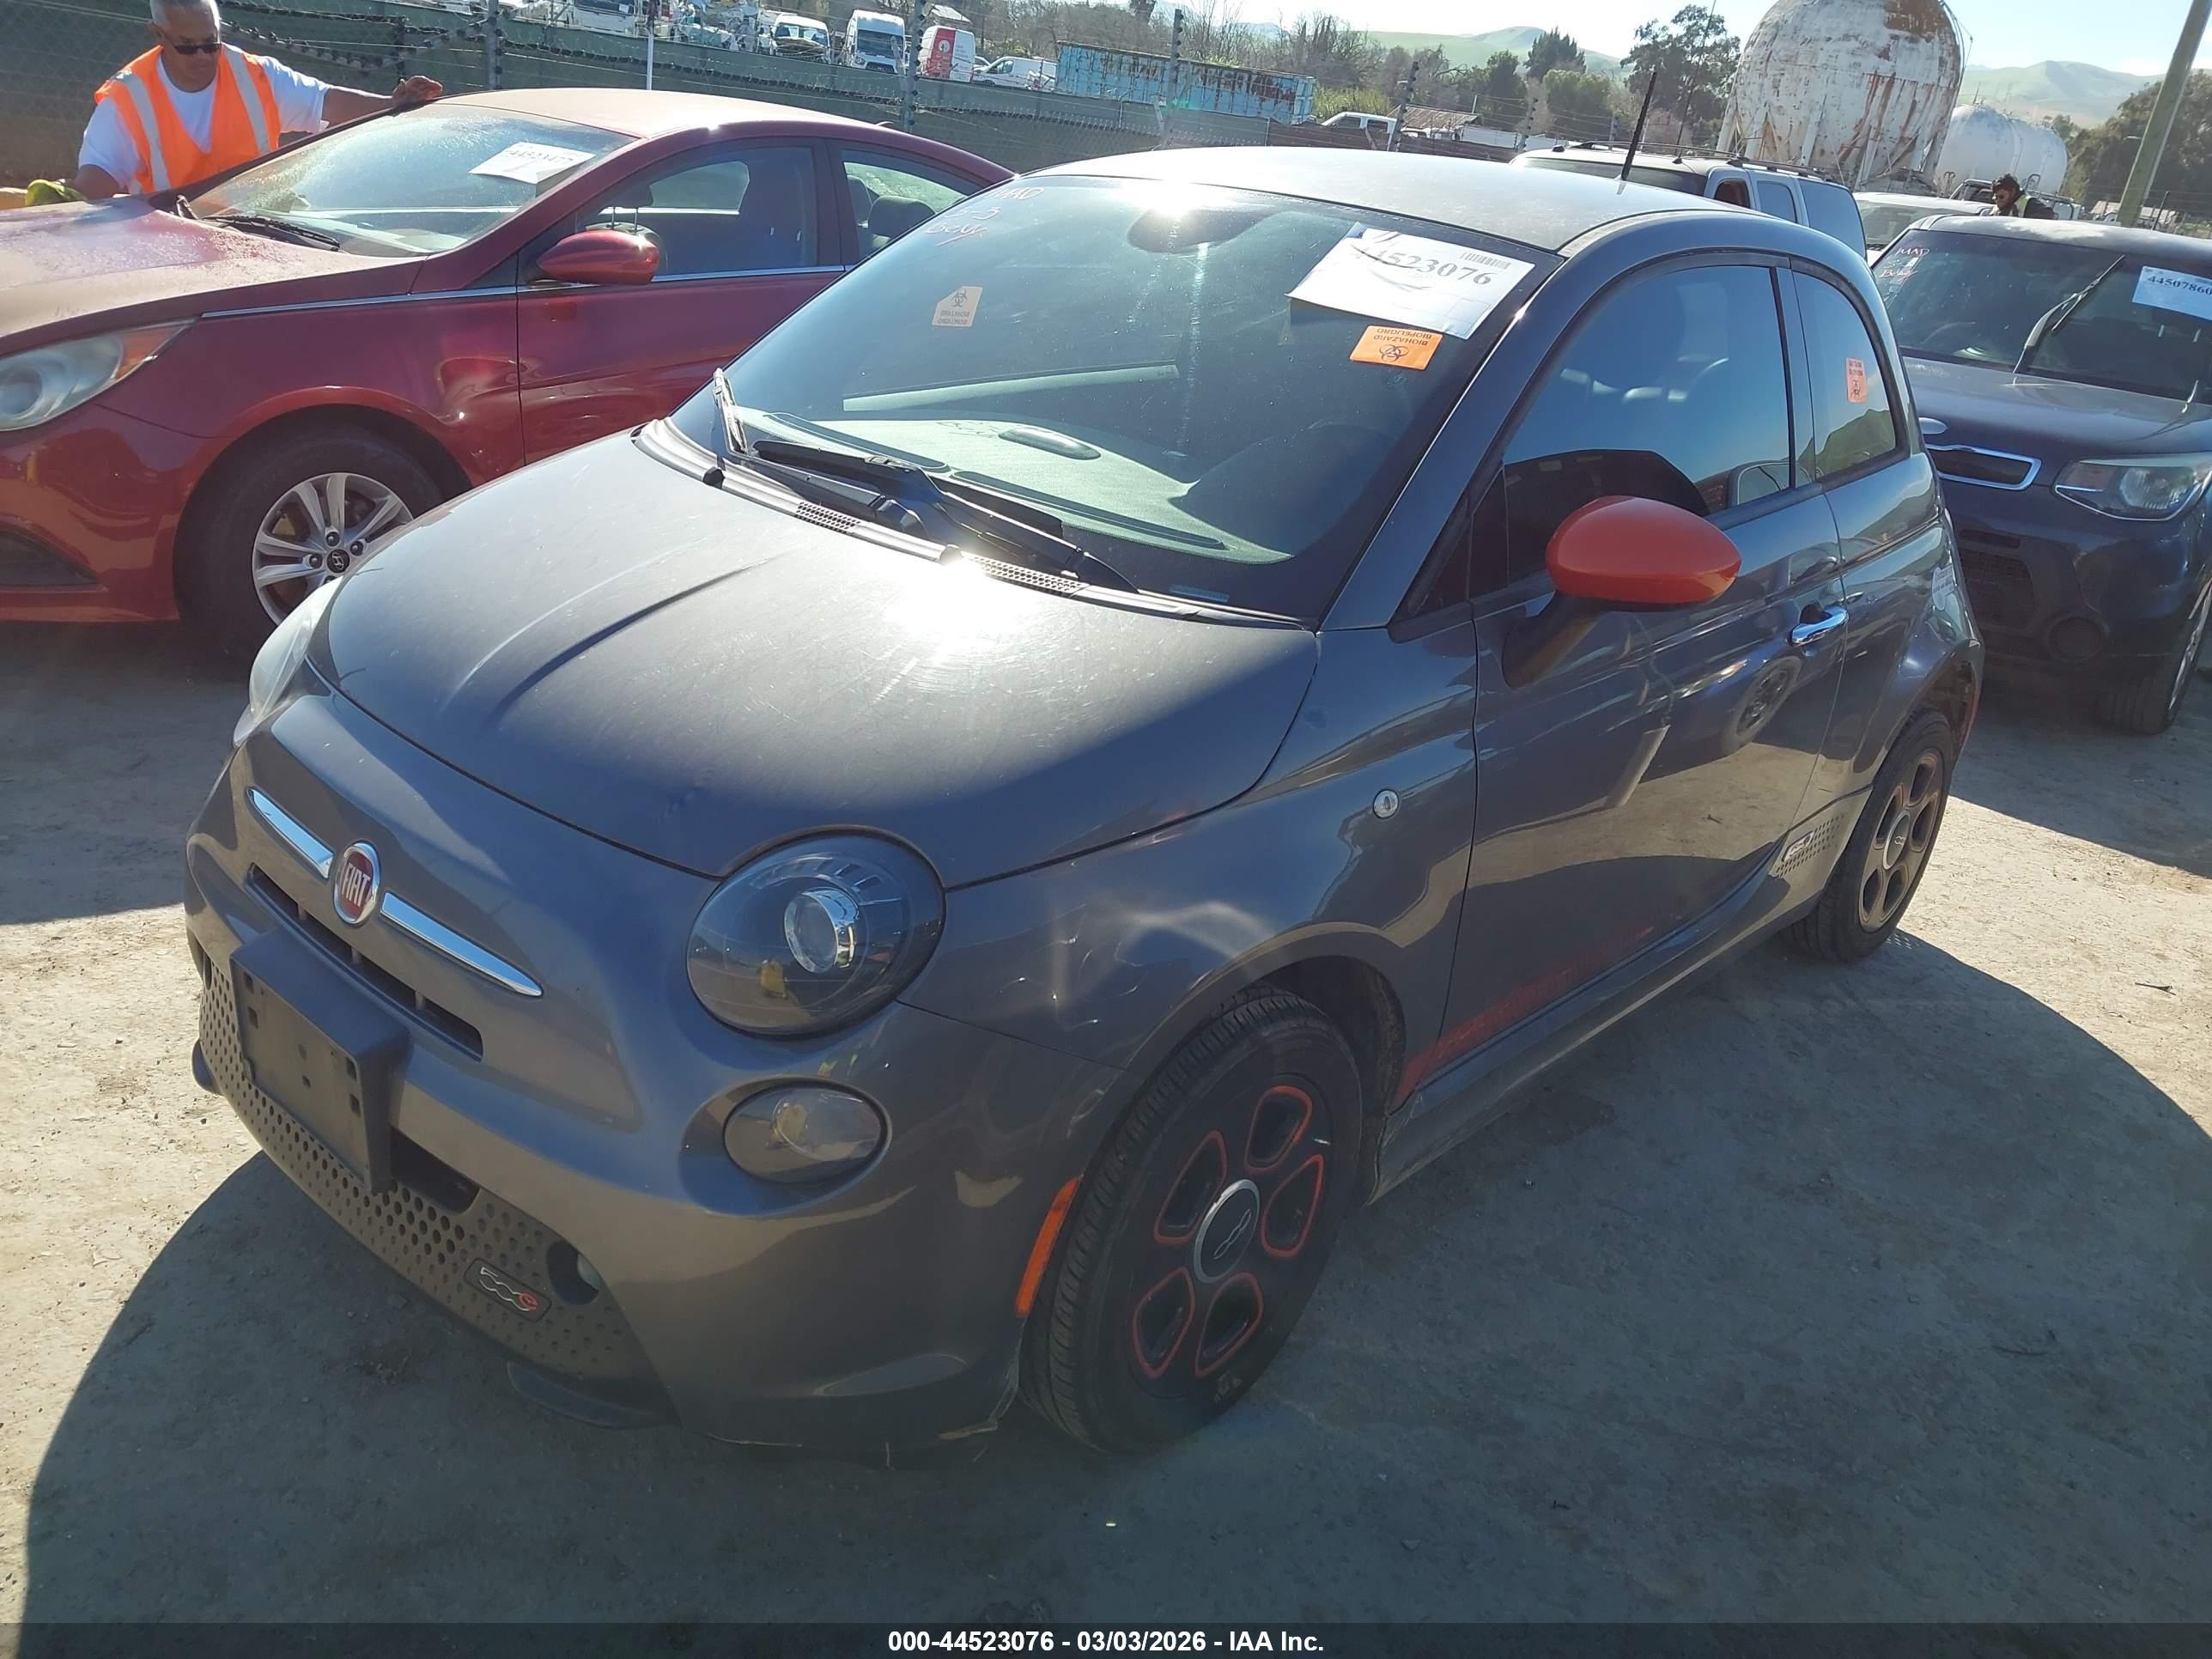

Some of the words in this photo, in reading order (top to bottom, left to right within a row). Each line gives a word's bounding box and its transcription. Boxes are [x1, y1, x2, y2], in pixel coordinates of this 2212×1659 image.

[1351, 246, 1498, 285] 523076
[2148, 276, 2212, 295] 44507860
[1373, 334, 1429, 347] BIOHAZARD
[1376, 328, 1432, 340] BIOPELIGRO
[341, 862, 372, 908] FIAT
